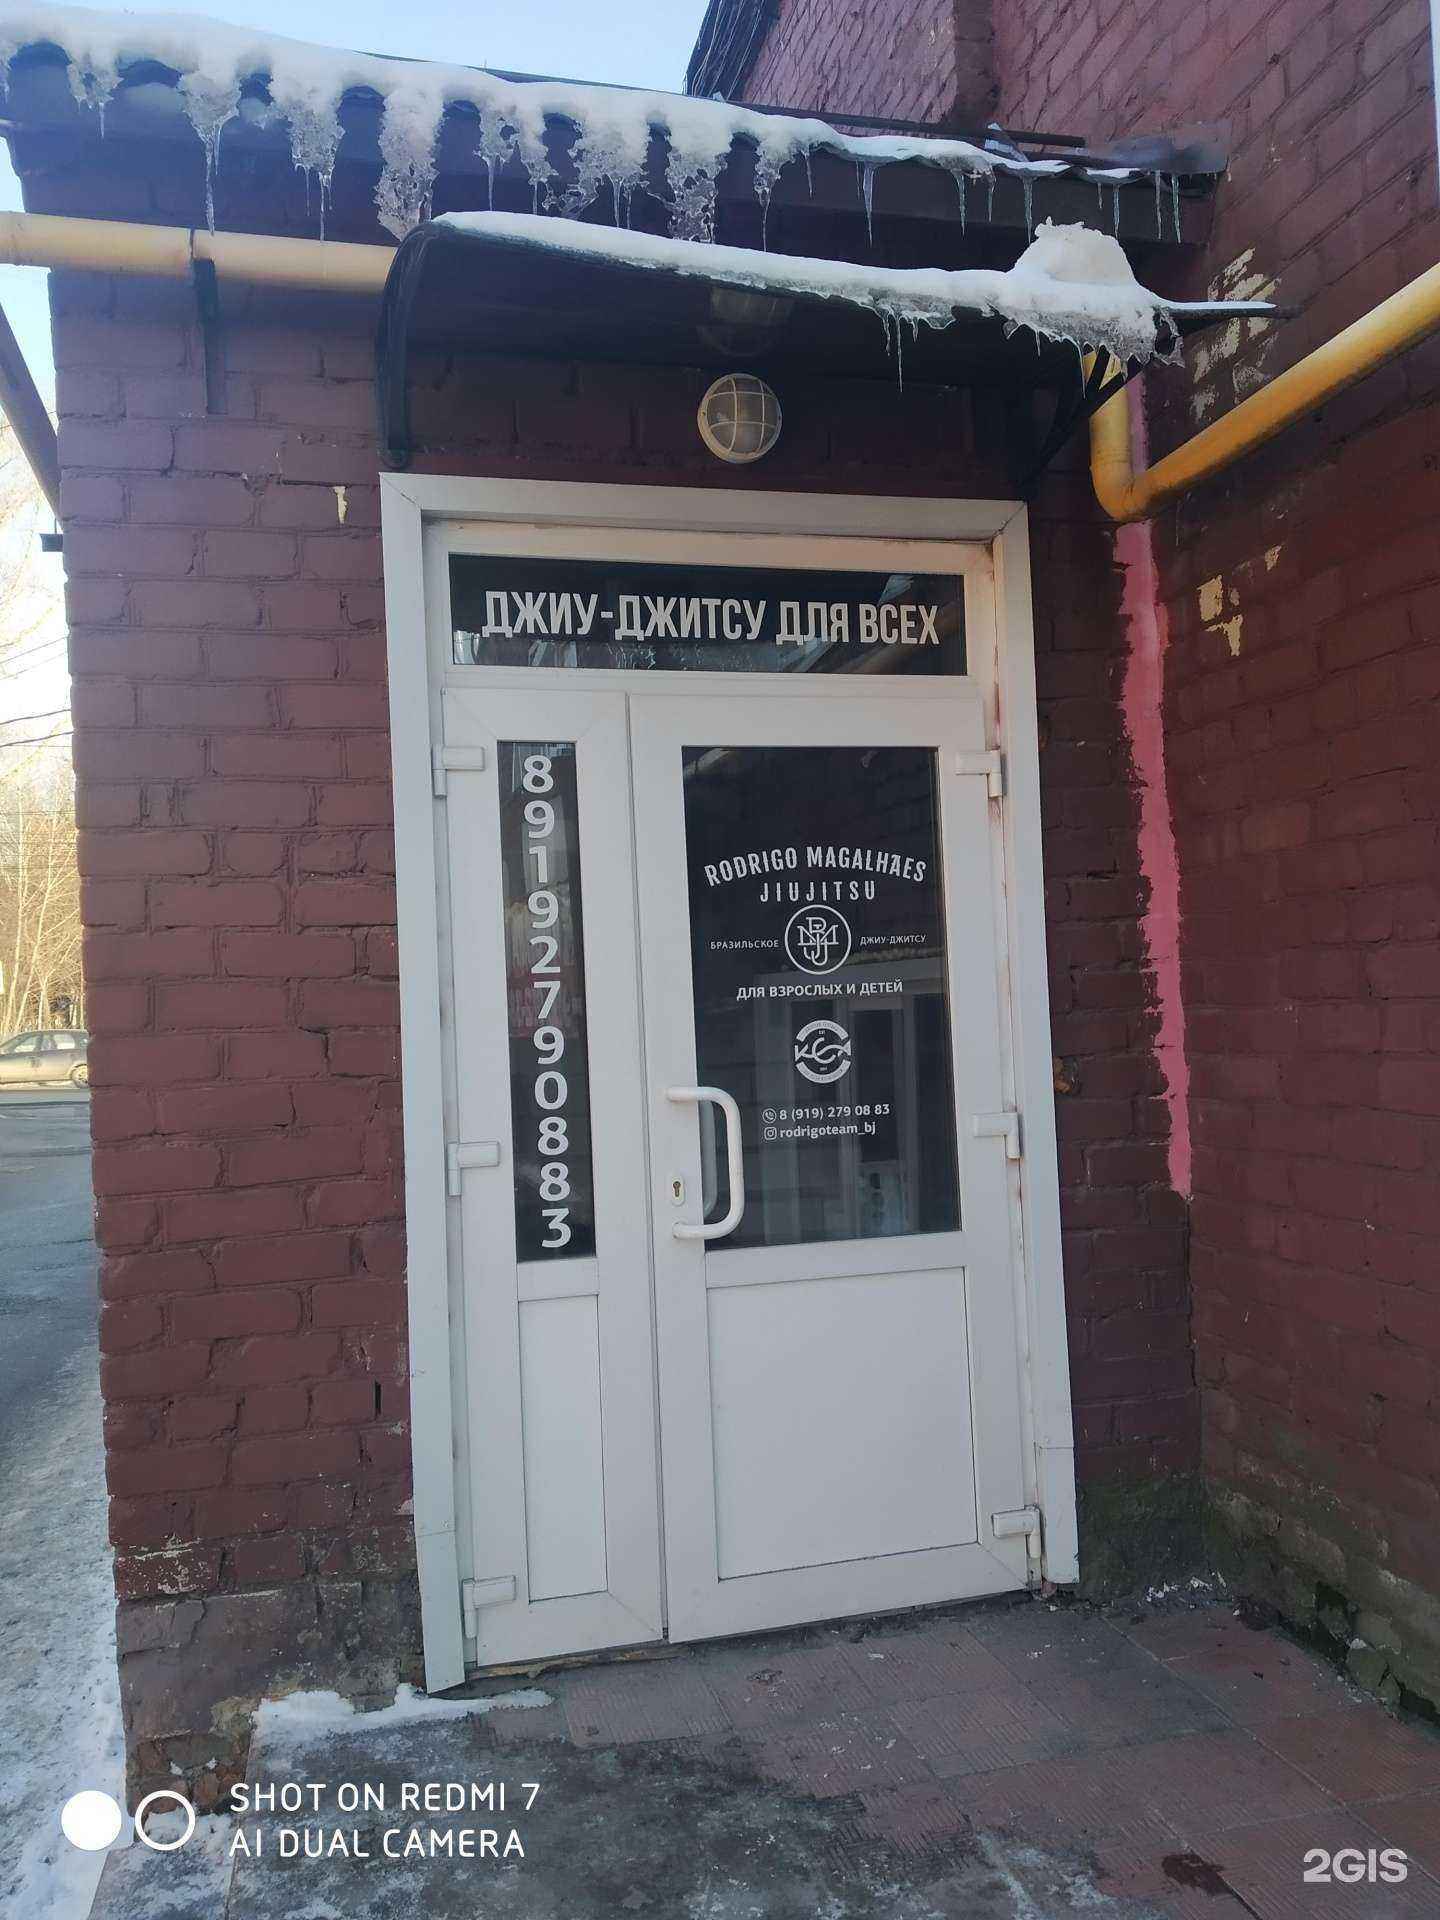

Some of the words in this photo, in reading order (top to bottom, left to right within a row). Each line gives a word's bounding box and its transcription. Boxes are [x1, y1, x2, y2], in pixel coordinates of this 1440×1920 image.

[481, 590, 766, 641] ДЖИУ-ДЖИТСУ
[775, 601, 849, 645] ДЛЯ
[858, 603, 940, 645] ВСЕХ
[703, 847, 798, 887] RODRIGO
[759, 881, 876, 902] JIUJITSU
[710, 939, 780, 950] БРАЗИЛЬСКОЕ
[859, 935, 926, 946] ДЖИУ-ДЖИТСУ
[736, 986, 766, 1001] ДЛЯ
[769, 983, 843, 998] ВЗРОСЛЫХ
[846, 983, 856, 995] И
[859, 978, 904, 996] ДЕТЕЙ
[522, 754, 572, 1249] 89192790883
[779, 1109, 788, 1121] 8
[792, 1108, 824, 1122] (919)
[828, 1107, 851, 1118] 279
[854, 1104, 871, 1116] 08
[874, 1104, 890, 1115] 83
[780, 1121, 877, 1139] rodrigoteam_bj
